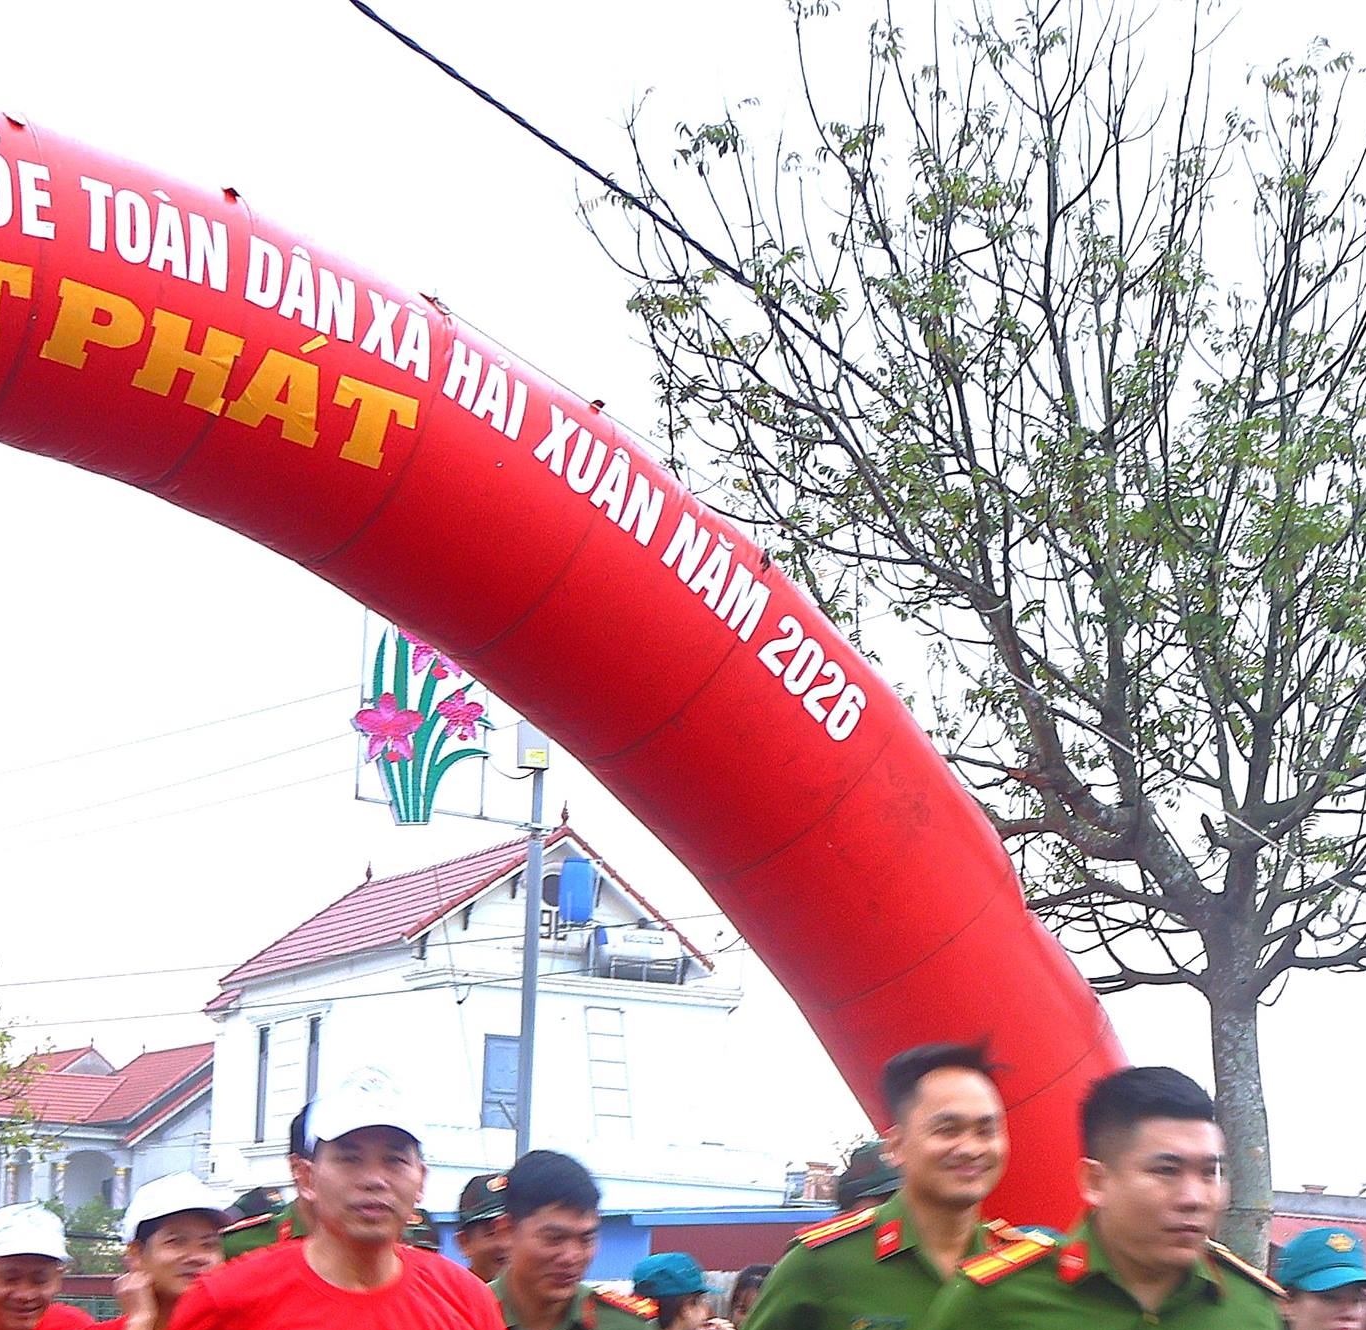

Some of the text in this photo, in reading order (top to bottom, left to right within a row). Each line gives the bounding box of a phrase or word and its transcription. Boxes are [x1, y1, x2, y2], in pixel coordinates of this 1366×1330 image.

[39, 278, 420, 469] PHÁT
[80, 175, 230, 292] TOÀN
[244, 236, 357, 343] DÂN
[359, 287, 432, 382] XÃ
[442, 338, 529, 440] HẢI
[533, 402, 666, 548] XUÂN
[661, 512, 772, 643] NĂM
[759, 615, 867, 742] 2026
